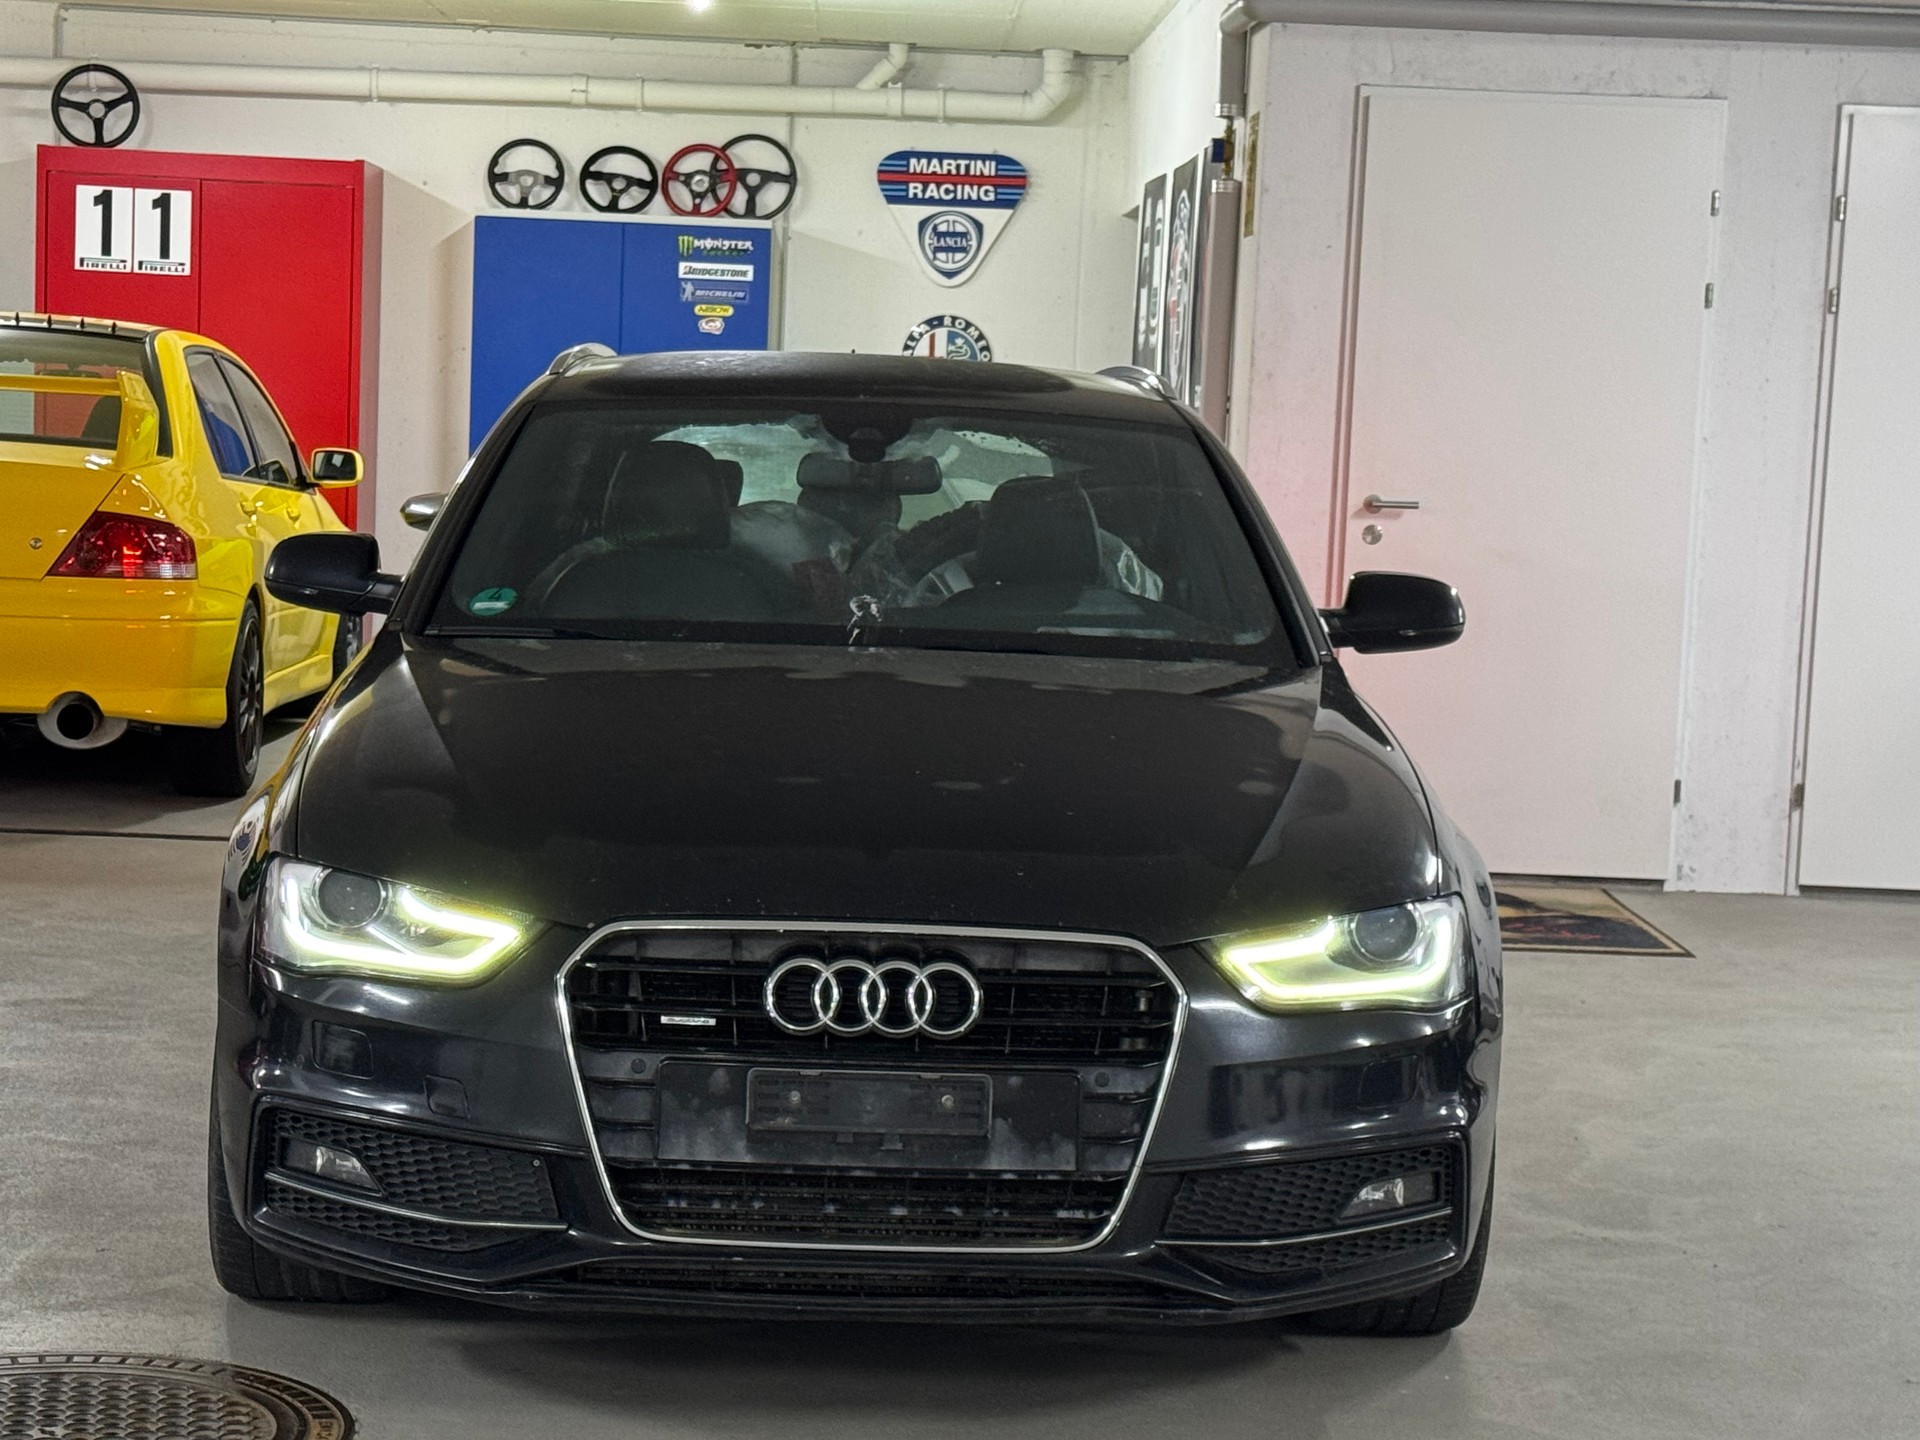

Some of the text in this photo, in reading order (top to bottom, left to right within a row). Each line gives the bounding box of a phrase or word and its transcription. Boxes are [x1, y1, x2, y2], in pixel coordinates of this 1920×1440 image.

[909, 158, 996, 176] MARTINI
[908, 183, 996, 201] RACING
[693, 238, 754, 251] MONSTER
[933, 236, 968, 248] LANCIA
[79, 257, 186, 273] PIRELLI PIRELLI
[682, 265, 750, 278] BRIDGESTONE
[695, 289, 746, 298] MICHELIN
